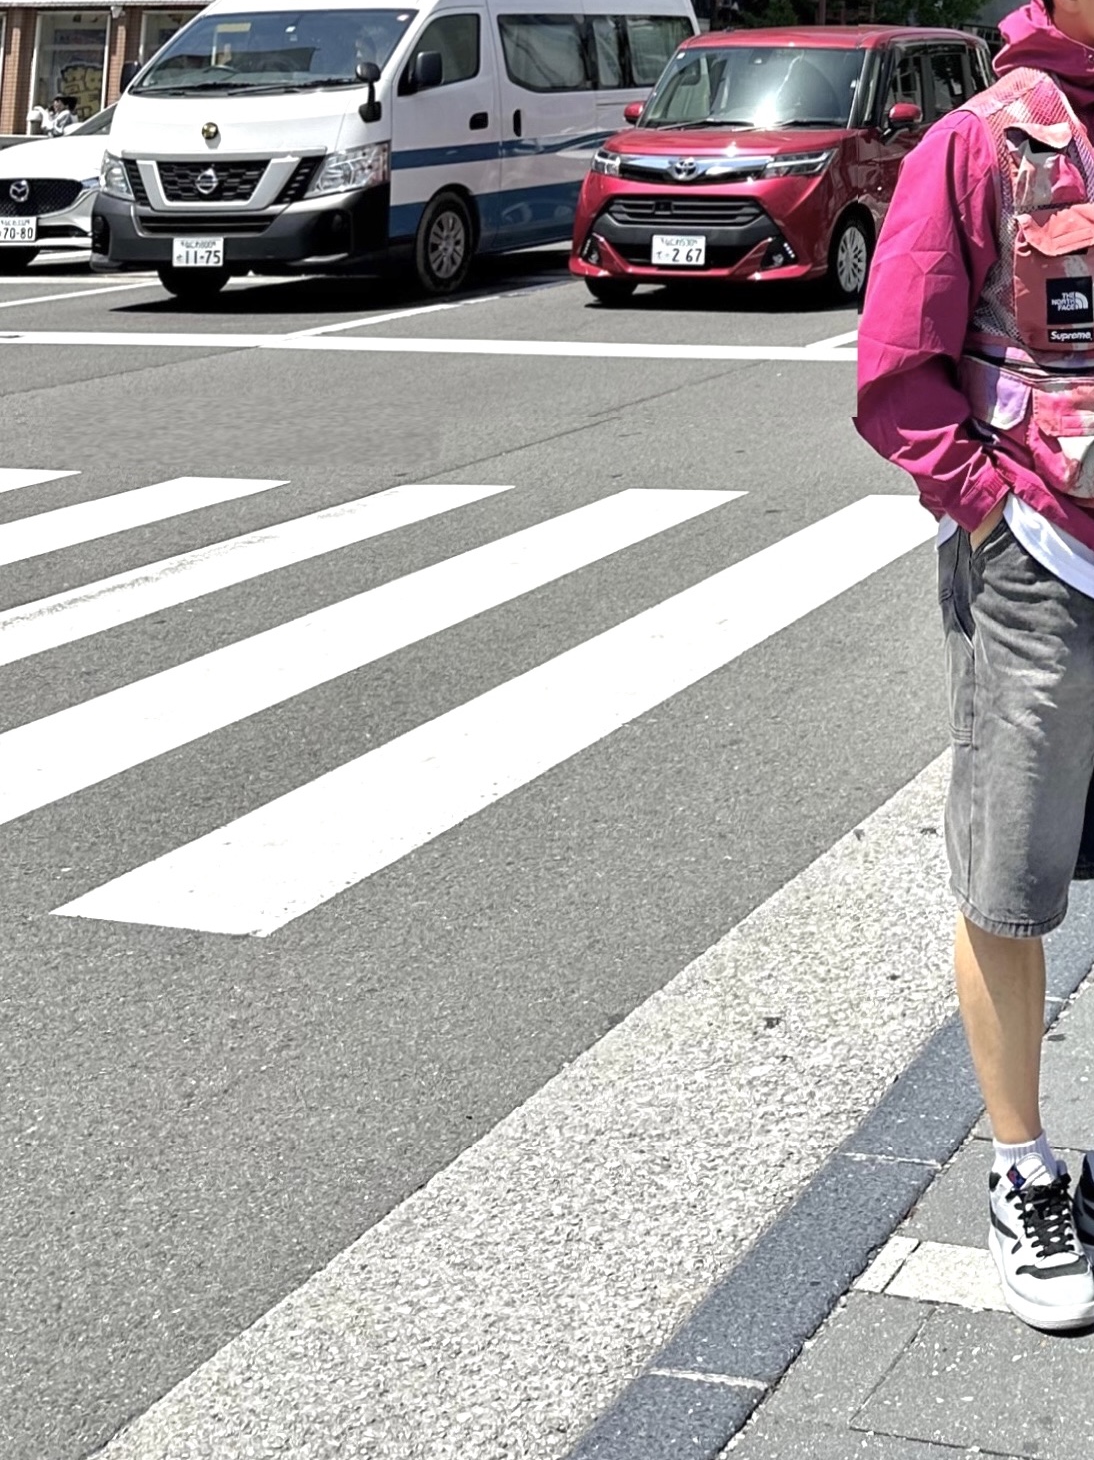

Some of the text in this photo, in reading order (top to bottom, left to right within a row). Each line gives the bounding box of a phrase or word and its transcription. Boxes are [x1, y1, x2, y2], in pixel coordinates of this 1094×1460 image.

[686, 248, 702, 262] 67
[1062, 292, 1074, 300] THE
[1051, 331, 1091, 341] Supreme
